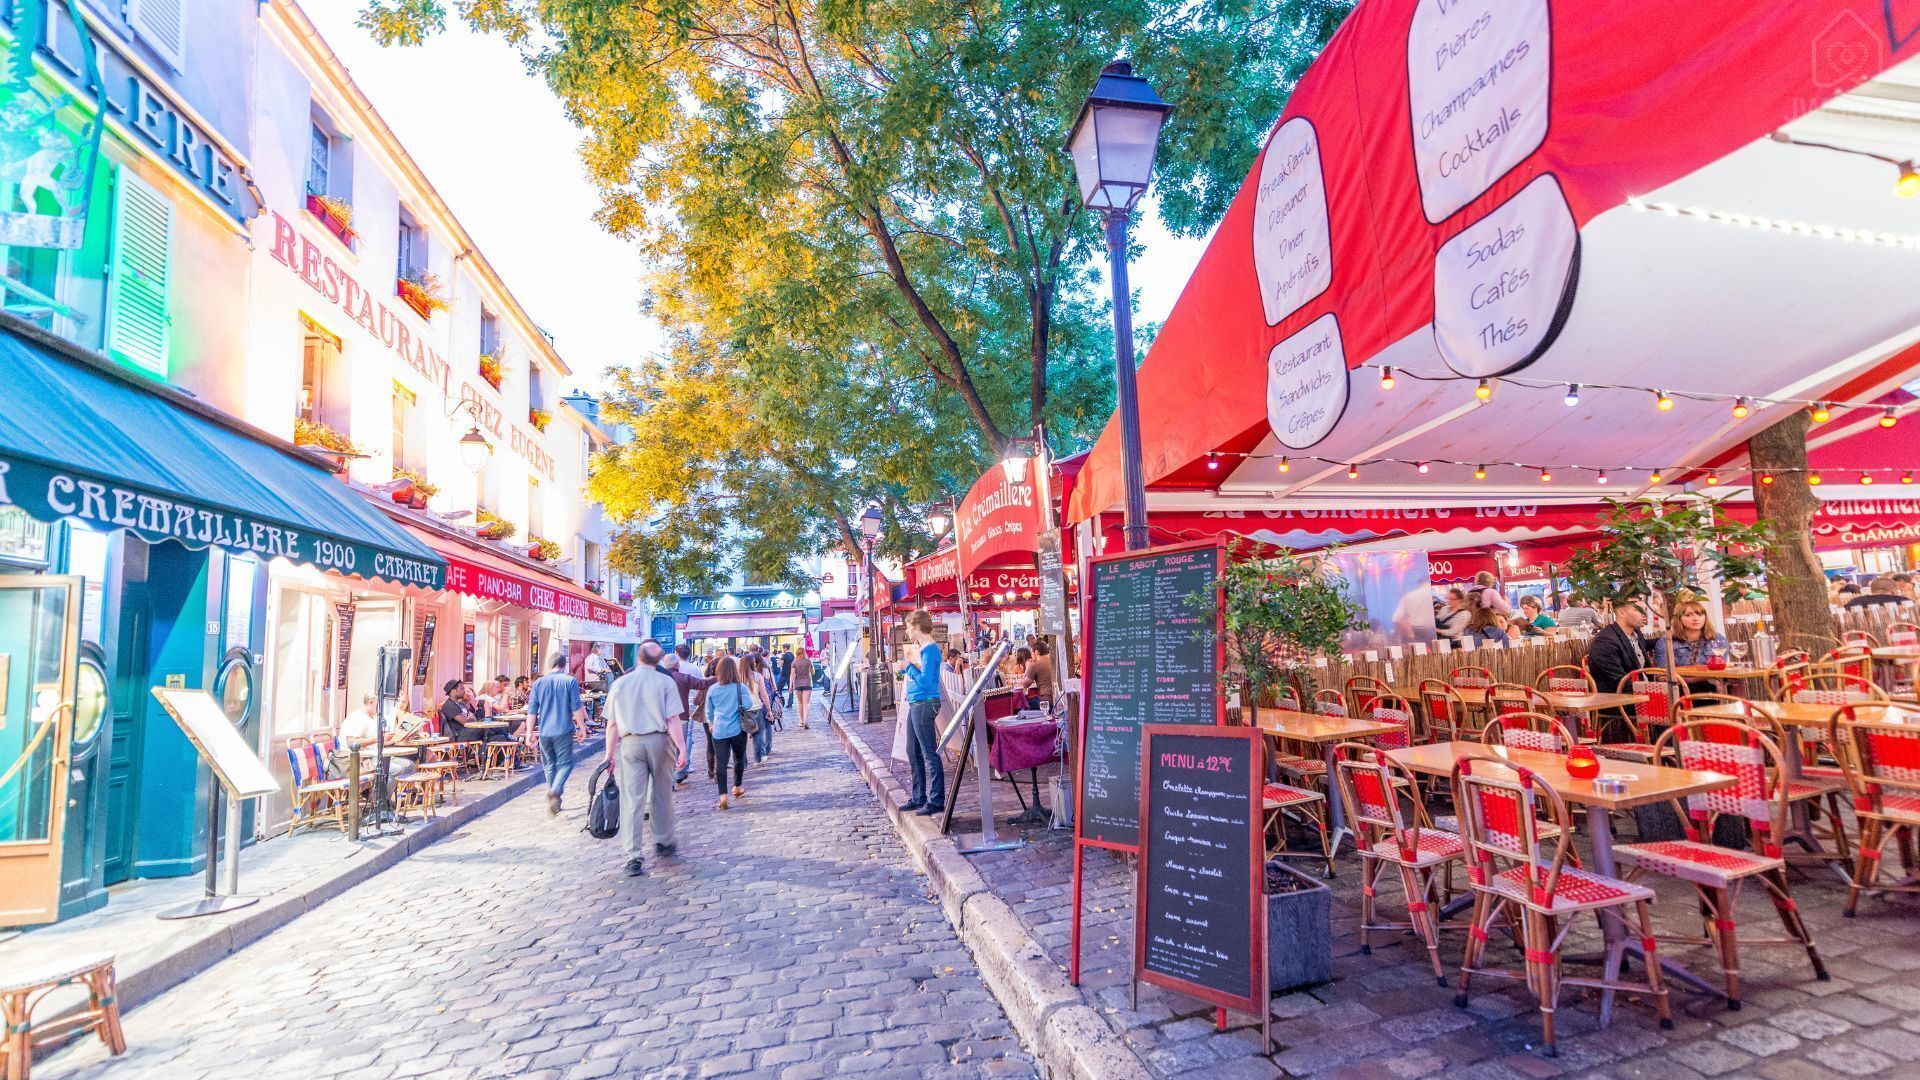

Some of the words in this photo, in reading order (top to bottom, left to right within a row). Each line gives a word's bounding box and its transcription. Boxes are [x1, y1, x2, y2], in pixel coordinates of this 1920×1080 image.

[1436, 11, 1492, 72] Bières
[1421, 39, 1531, 141] Champagnes
[1439, 106, 1522, 178] Cocktails
[1259, 140, 1313, 203] Breakfast
[1268, 182, 1309, 232] Déjeuner
[1466, 223, 1525, 270] Sodas
[1275, 252, 1320, 301] Apéritifs
[1470, 267, 1530, 310] Cafés
[270, 209, 453, 396] RESTAURANT
[1274, 332, 1333, 376] Restaurant
[1478, 316, 1529, 350] Thés
[1279, 369, 1333, 409] Sandwichs
[1288, 407, 1326, 434] Crêpes
[509, 423, 556, 483] EUGENE
[47, 475, 300, 560] CREMAILLERE
[313, 538, 356, 569] 1900
[374, 552, 438, 586] CABARET
[968, 573, 991, 589] La
[1109, 565, 1119, 573] LE
[1130, 560, 1157, 570] SABOT
[1165, 555, 1194, 566] ROUGE
[477, 571, 523, 601] PIANO-BAR
[528, 584, 556, 611] CHEZ
[558, 593, 591, 618] EUGENE
[1161, 753, 1194, 769] MENU
[1197, 759, 1205, 769] à
[1163, 780, 1193, 793] Omelette
[1164, 806, 1183, 817] Quiche
[1164, 831, 1185, 844] Croque
[1199, 867, 1223, 877] chocolat
